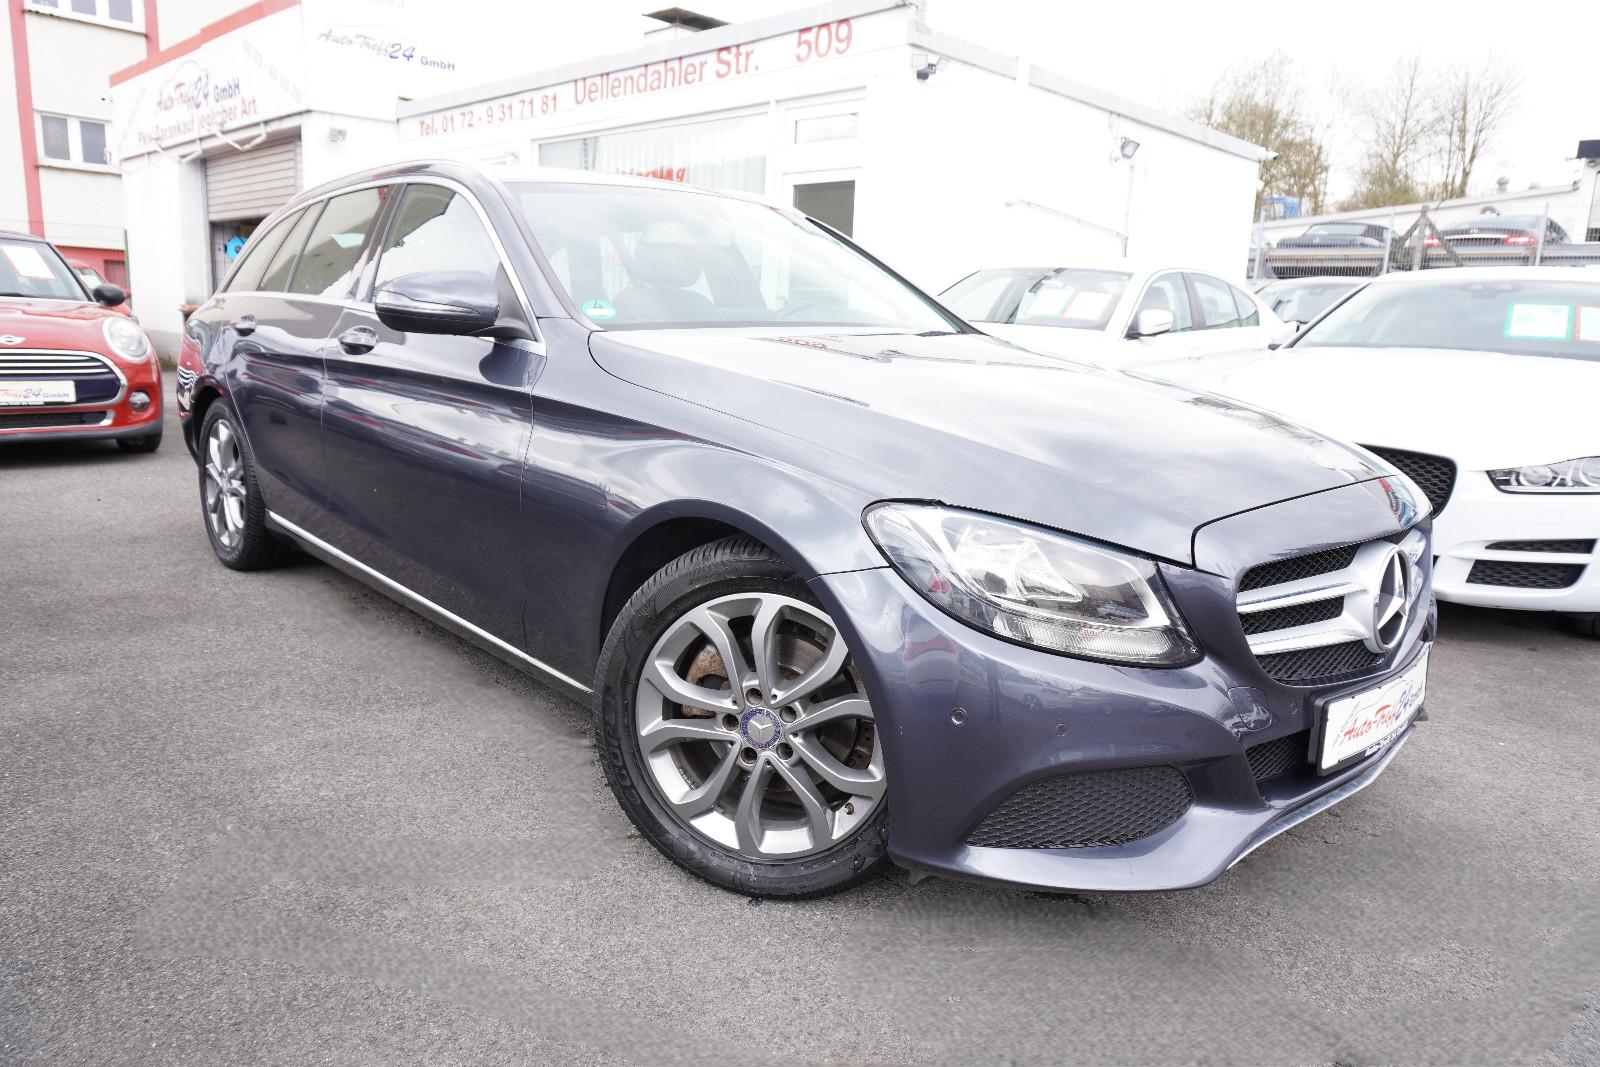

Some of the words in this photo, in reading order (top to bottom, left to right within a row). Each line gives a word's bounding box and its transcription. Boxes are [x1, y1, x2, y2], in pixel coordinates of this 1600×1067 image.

[420, 56, 456, 71] GmbH
[574, 57, 707, 105] Uellendahler
[716, 45, 759, 79] Str.
[795, 19, 853, 63] 509
[213, 76, 241, 103] GmbH
[241, 96, 258, 118] Art
[419, 116, 438, 137] Tel.
[442, 115, 455, 133] 01
[459, 111, 474, 128] 72
[487, 106, 494, 124] 9
[499, 102, 514, 122] 31
[519, 97, 534, 117] 71
[541, 93, 558, 114] 81
